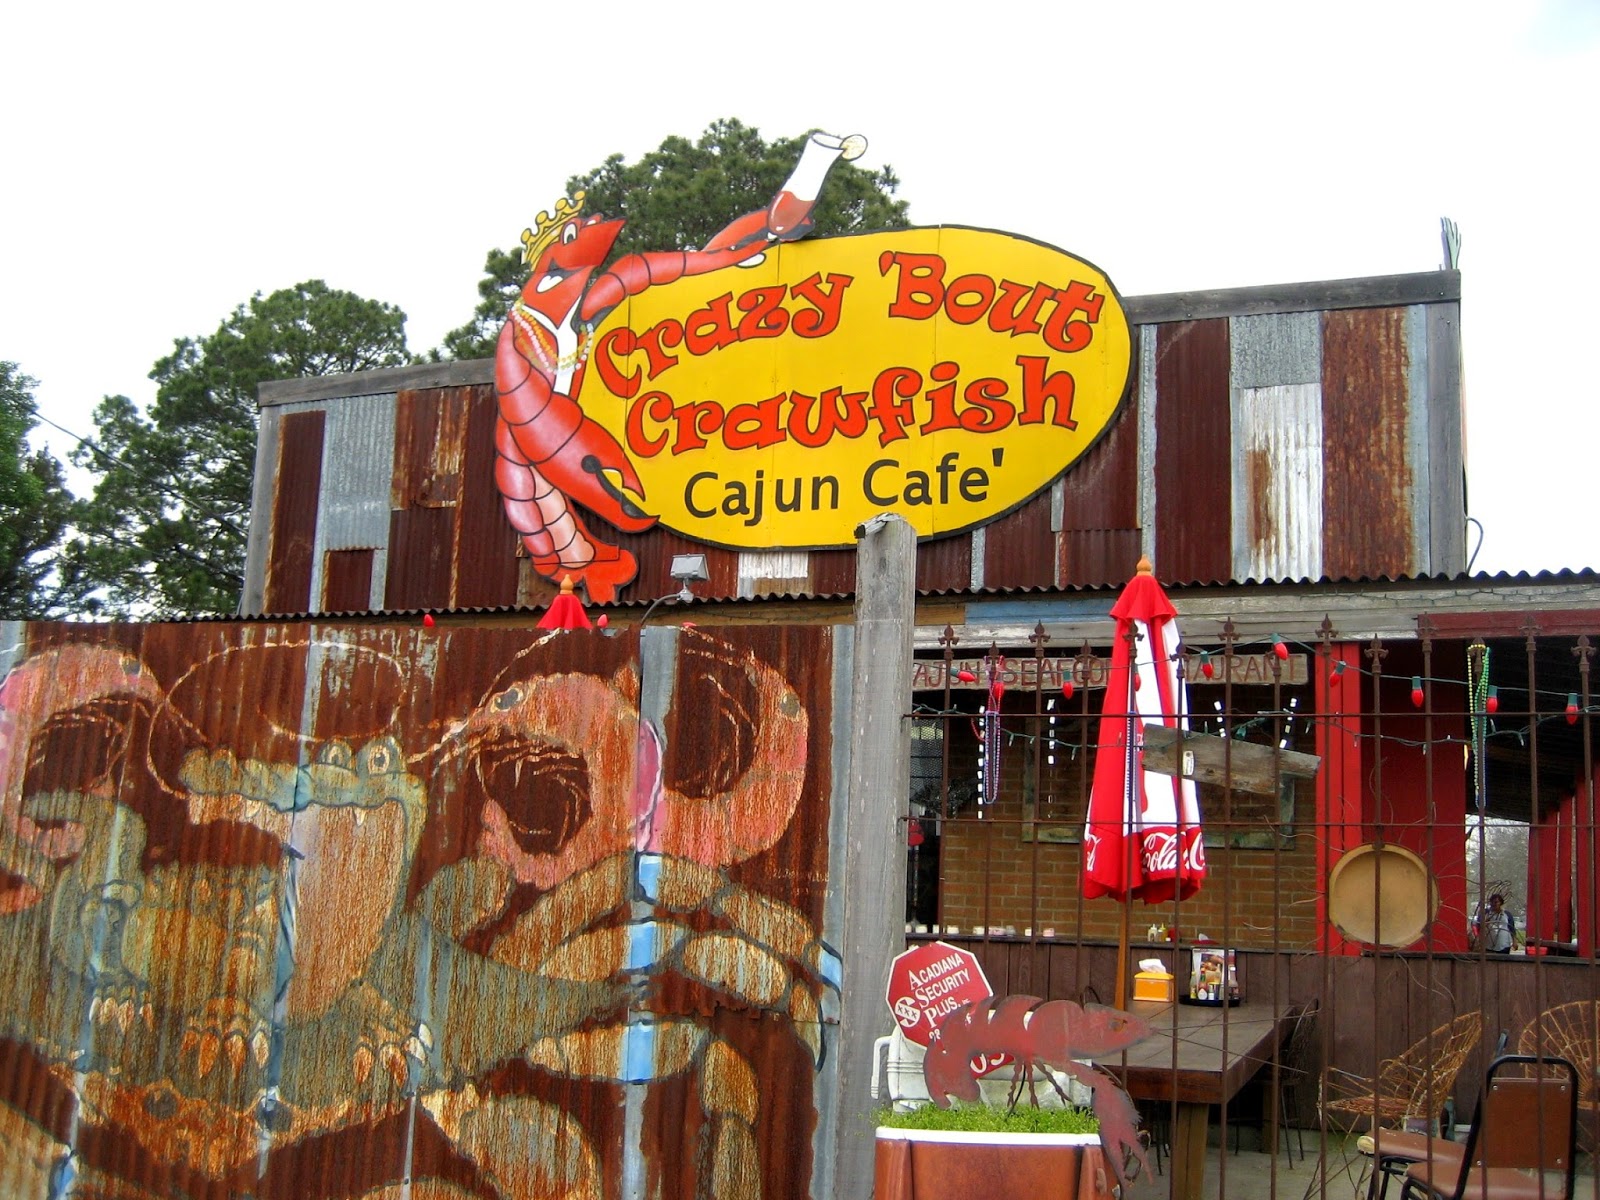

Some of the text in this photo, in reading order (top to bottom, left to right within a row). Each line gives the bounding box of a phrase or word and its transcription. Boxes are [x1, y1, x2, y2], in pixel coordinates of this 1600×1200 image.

[595, 250, 1106, 399] Crazy 'Bout
[626, 355, 1080, 458] Crawfish
[684, 447, 1004, 527] Cajun Cafe'
[912, 661, 981, 688] AJUN
[908, 952, 965, 991] ACADIANA
[914, 967, 971, 1009] SECURITY
